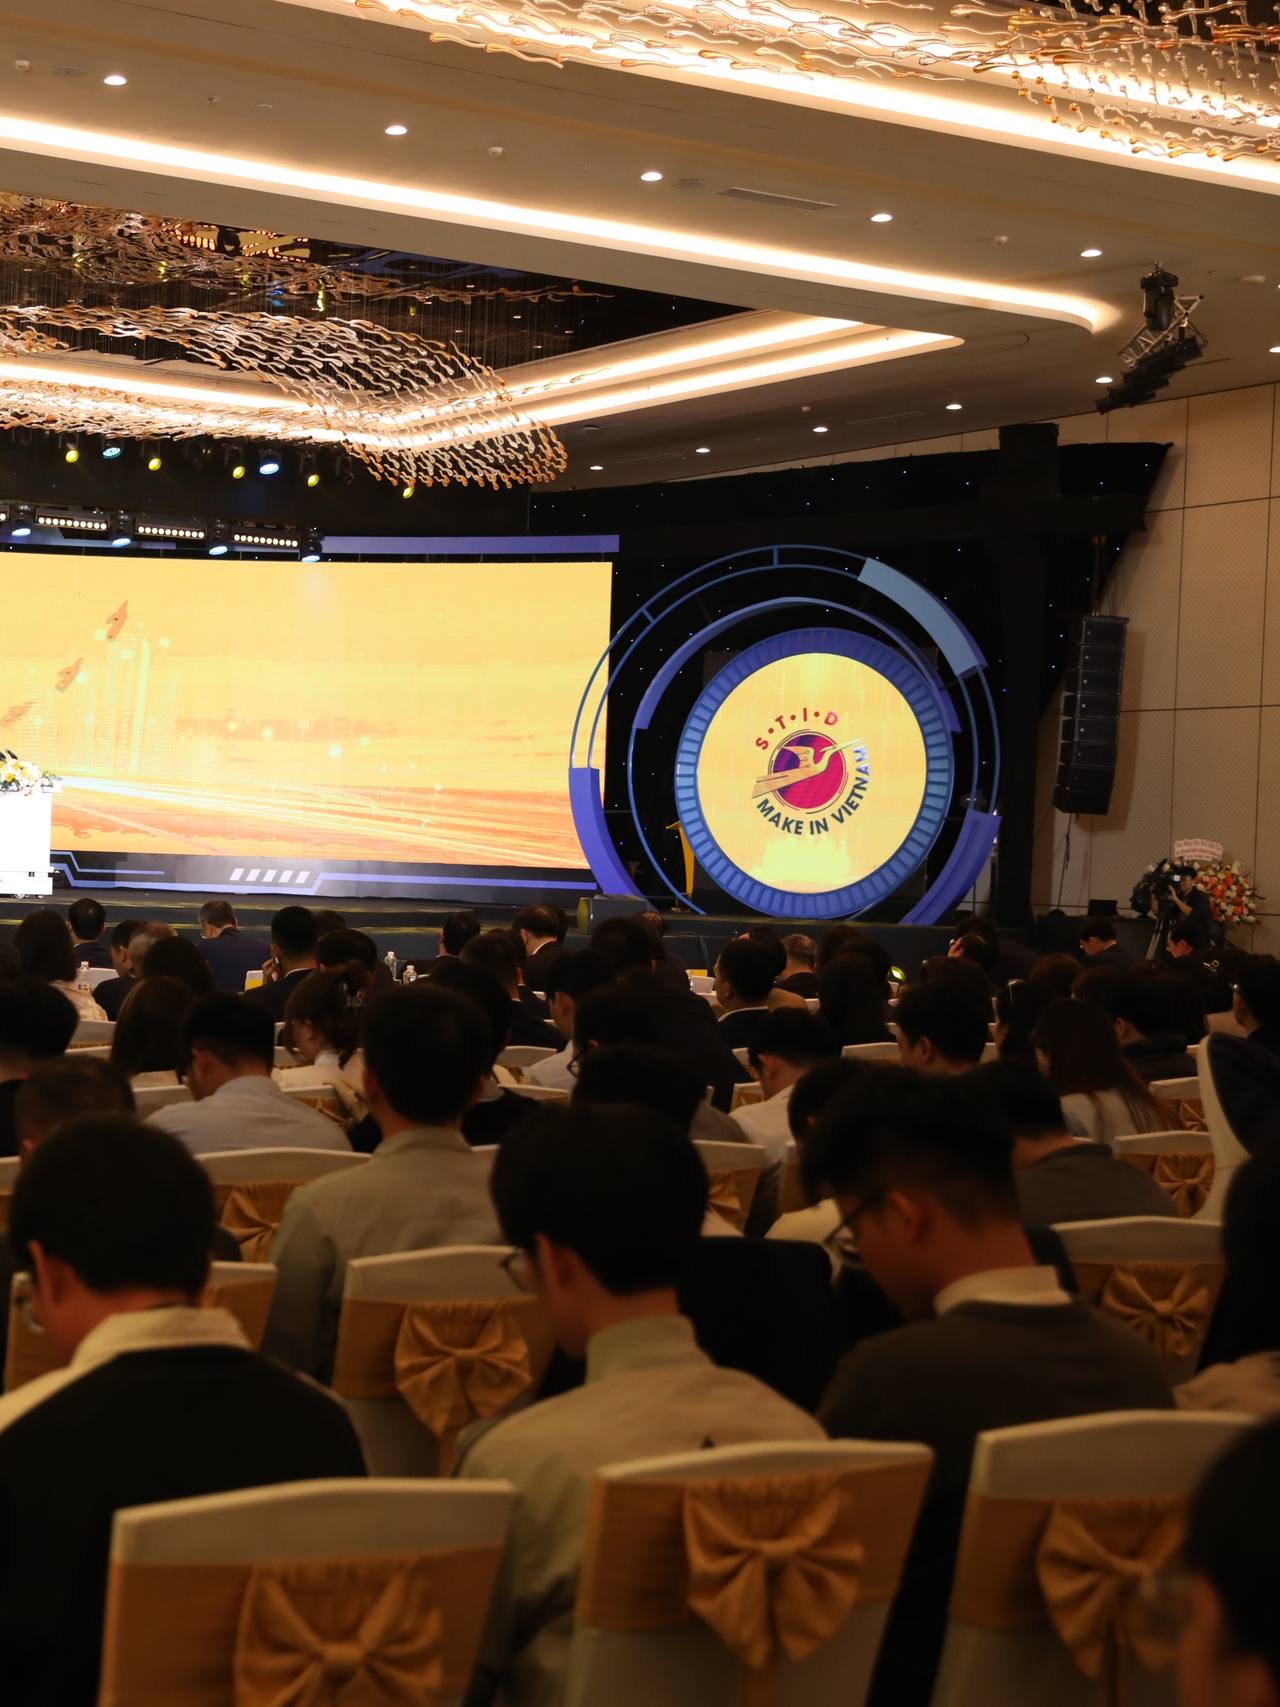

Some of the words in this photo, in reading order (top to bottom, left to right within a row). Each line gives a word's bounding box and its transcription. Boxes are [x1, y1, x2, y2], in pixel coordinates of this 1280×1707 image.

[756, 798, 804, 835] MAKE
[809, 817, 829, 835] IN
[831, 743, 871, 824] VIETNAM
